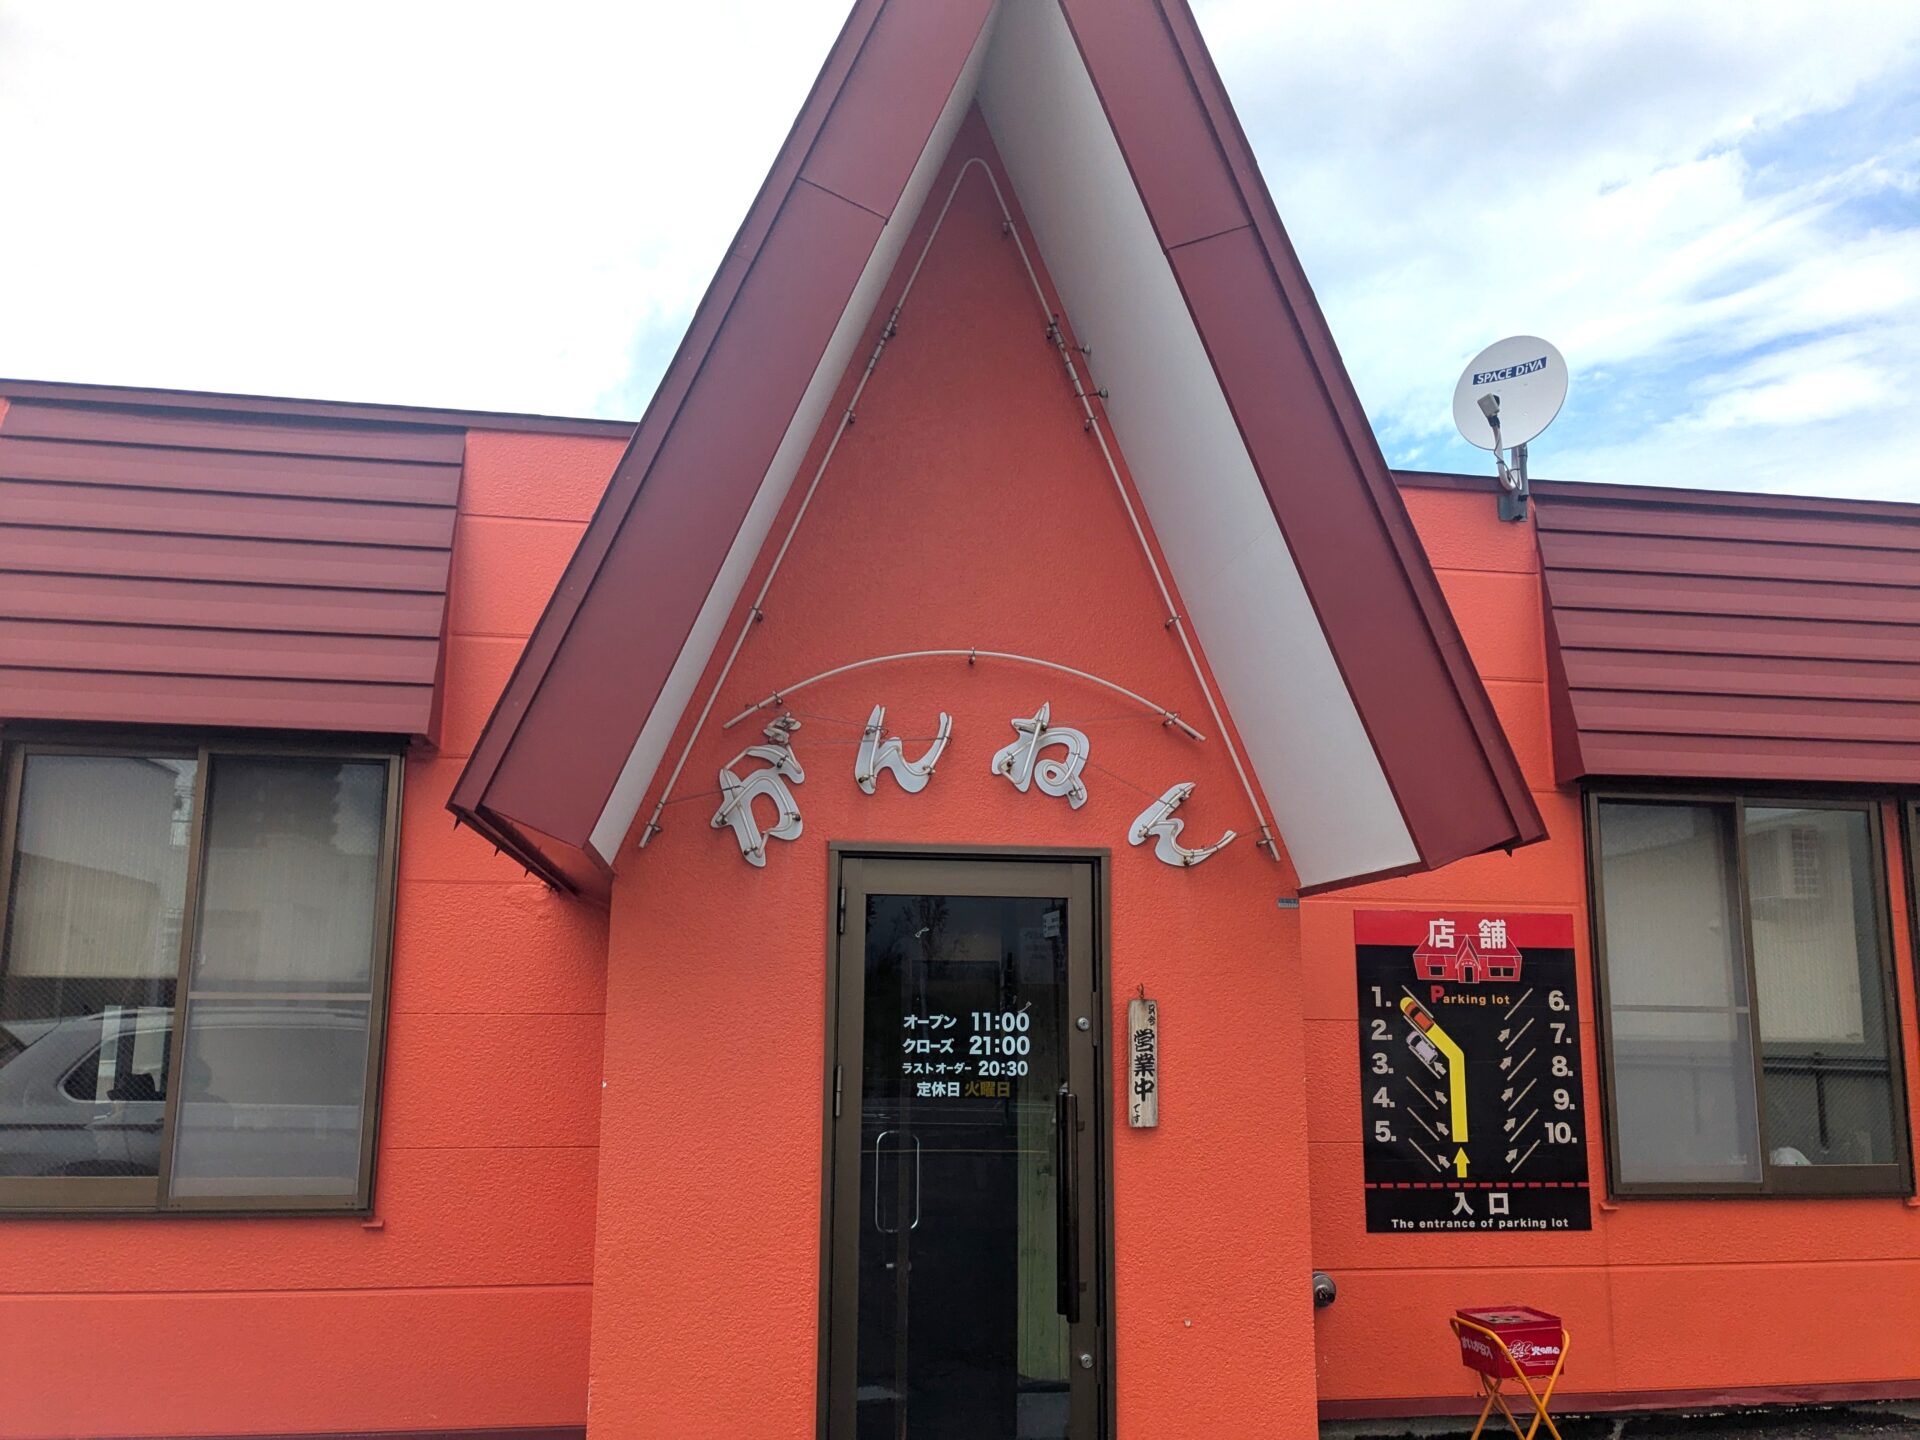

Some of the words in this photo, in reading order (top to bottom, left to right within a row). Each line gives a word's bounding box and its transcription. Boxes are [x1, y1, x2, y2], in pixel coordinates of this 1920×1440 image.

[1477, 368, 1512, 384] SPACE
[711, 701, 1236, 867] がんねん
[1428, 918, 1507, 949] 店舗
[1371, 986, 1392, 1007] 1.
[1430, 985, 1486, 1006] Parking
[1492, 994, 1510, 1004] lot
[1548, 990, 1570, 1011] 6.
[903, 1014, 957, 1030] オープン
[970, 1012, 1030, 1032] 11:00
[1371, 1019, 1393, 1040] 2.
[1550, 1023, 1572, 1044] 7.
[902, 1038, 954, 1054] クローズ
[969, 1035, 1030, 1056] 21:00
[902, 1062, 971, 1075] ラストオーダー
[978, 1060, 1028, 1076] 20:30
[1134, 1029, 1155, 1102] 営業中
[1372, 1053, 1394, 1074] 3.
[1551, 1055, 1574, 1077] 8.
[917, 1082, 960, 1098] 定休日
[965, 1082, 1010, 1098] 火曜日
[1372, 1087, 1395, 1108] 4.
[1553, 1088, 1576, 1111] 9.
[1375, 1121, 1397, 1142] 5.
[1544, 1122, 1577, 1144] 10.
[1452, 1192, 1509, 1215] 入口
[1391, 1219, 1414, 1229] The
[1419, 1218, 1475, 1229] entrance
[1480, 1218, 1494, 1228] of
[1499, 1217, 1547, 1229] parking
[1551, 1217, 1568, 1228] lot
